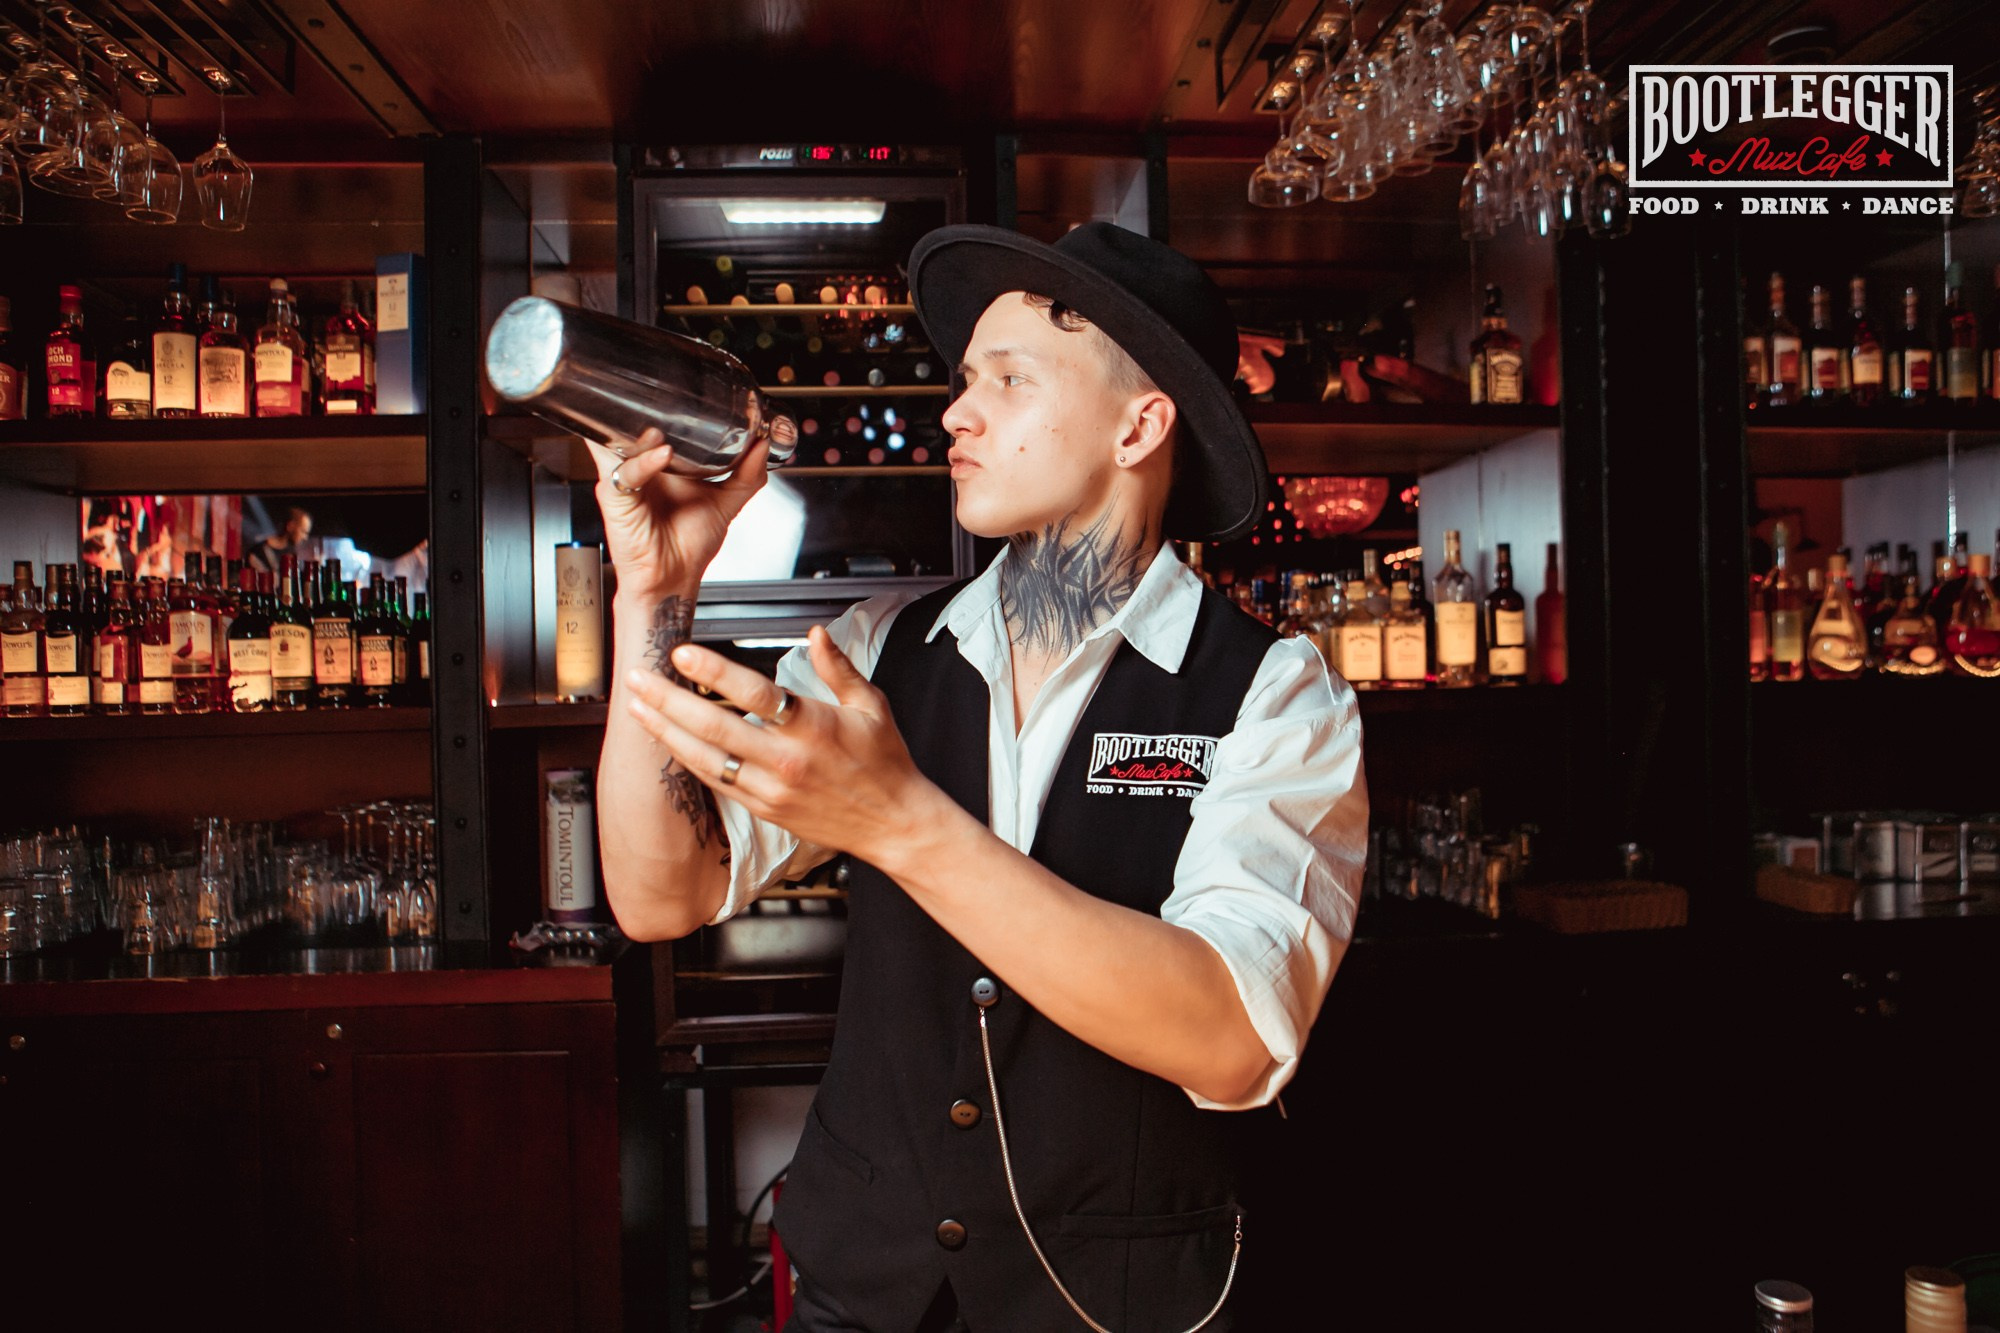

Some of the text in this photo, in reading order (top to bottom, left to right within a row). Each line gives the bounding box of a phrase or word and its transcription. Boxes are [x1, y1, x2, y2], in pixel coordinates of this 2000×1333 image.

[759, 148, 793, 160] POZIS
[47, 355, 73, 363] MOND
[163, 375, 174, 385] 12
[566, 622, 579, 634] 12
[1092, 736, 1217, 781] BOOTLEGGER
[1086, 784, 1201, 798] FOOD DRINK DAN
[558, 806, 574, 905] TOMINTOUL
